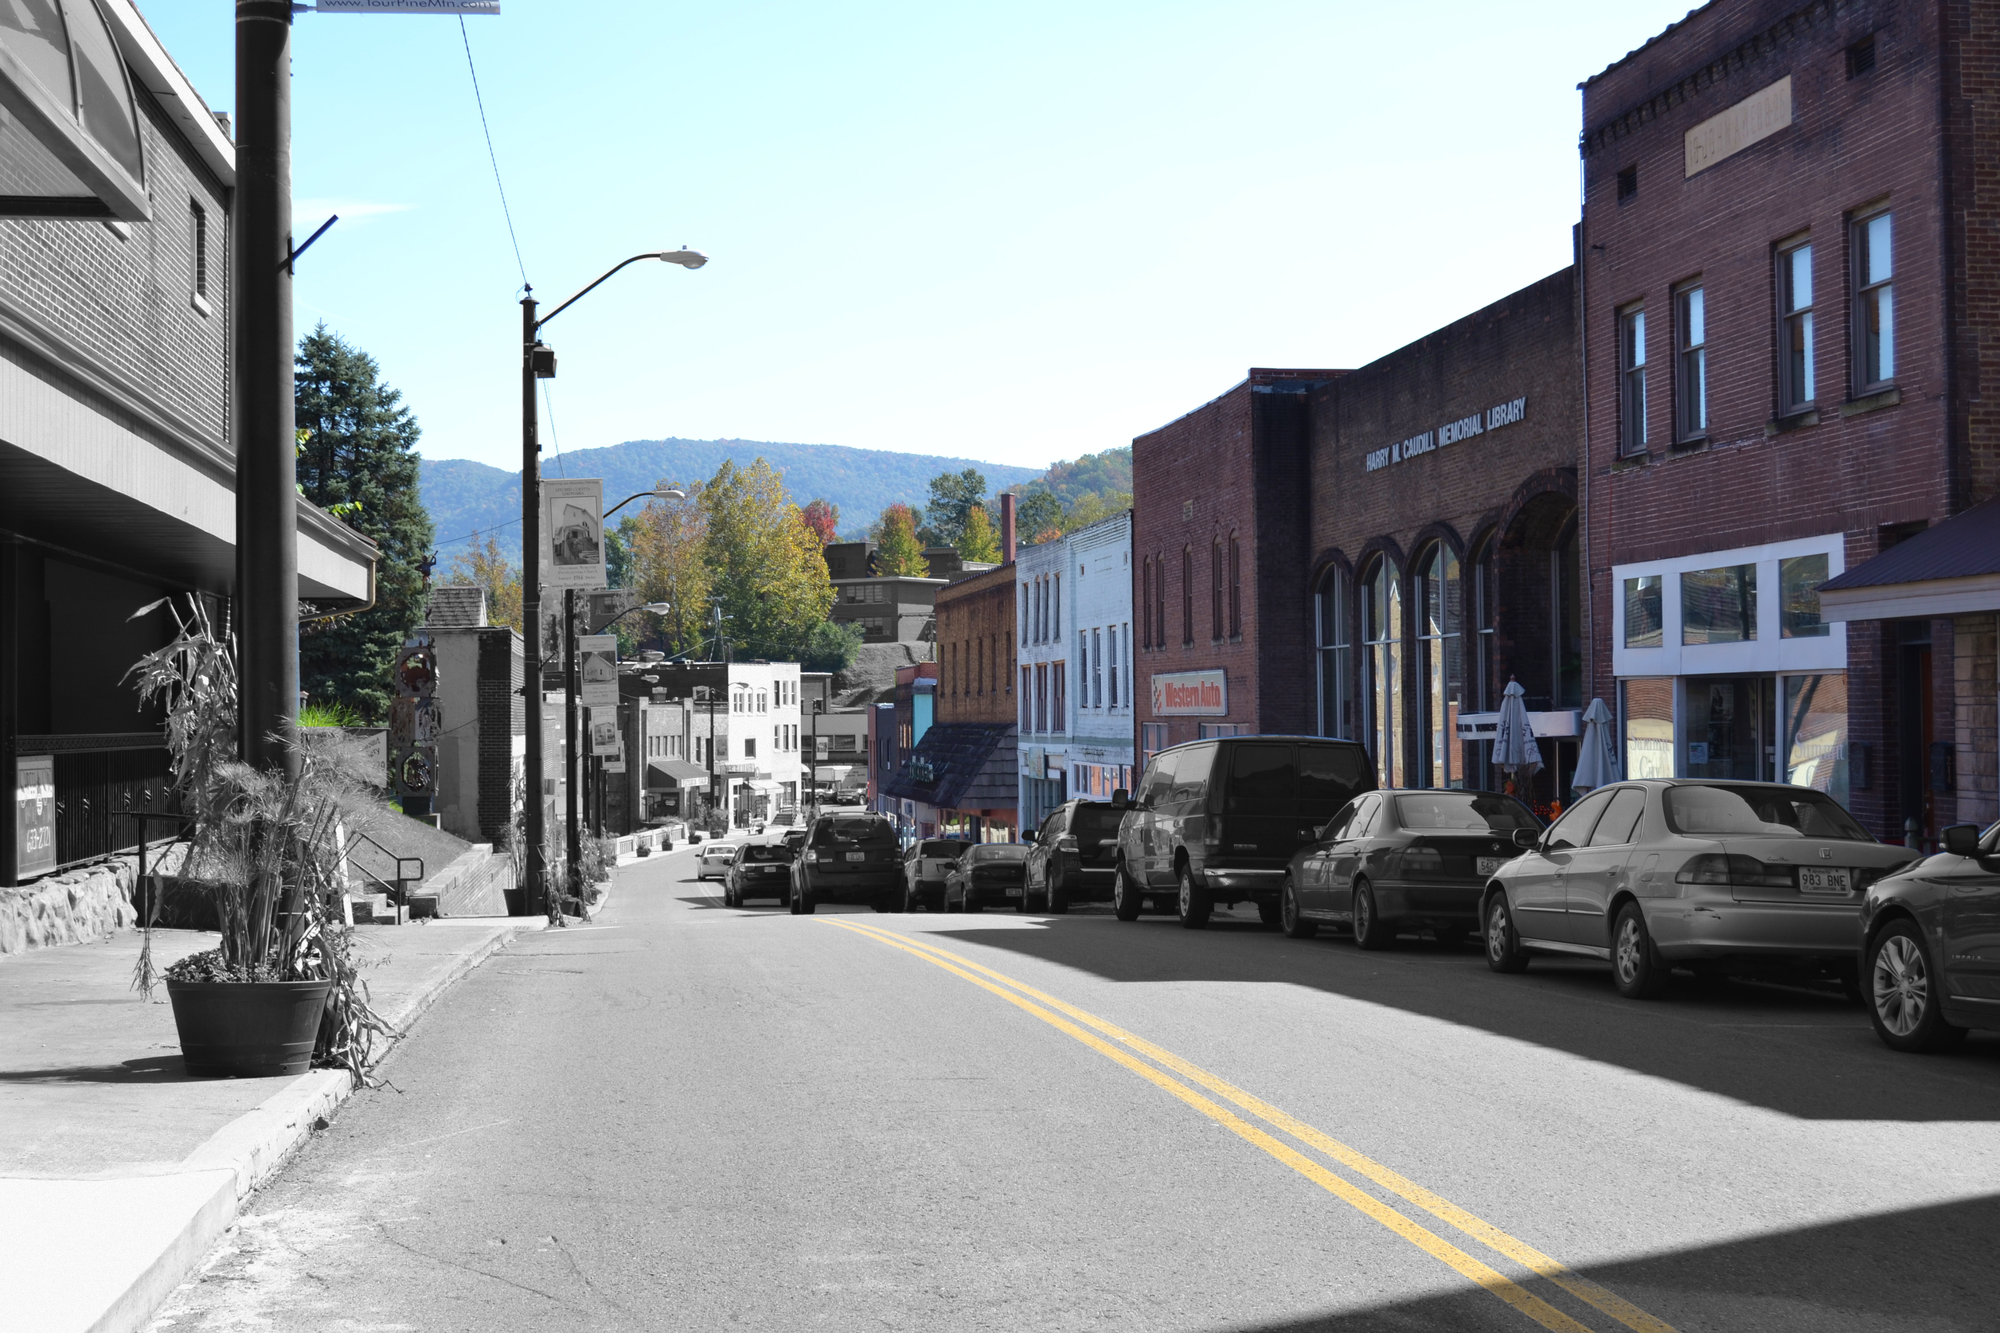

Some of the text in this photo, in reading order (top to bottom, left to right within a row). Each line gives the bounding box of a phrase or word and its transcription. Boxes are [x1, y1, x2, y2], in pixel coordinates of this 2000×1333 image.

[1366, 396, 1528, 472] HARRY M. CAUDILL MEMORIAL LIBRARY
[1164, 680, 1222, 708] Western Auto
[1630, 727, 1669, 751] Summit
[1794, 732, 1844, 760] Summit
[1481, 861, 1494, 871] 542
[1802, 873, 1846, 887] 983 BNE
[1951, 954, 1982, 962] IMPALA
